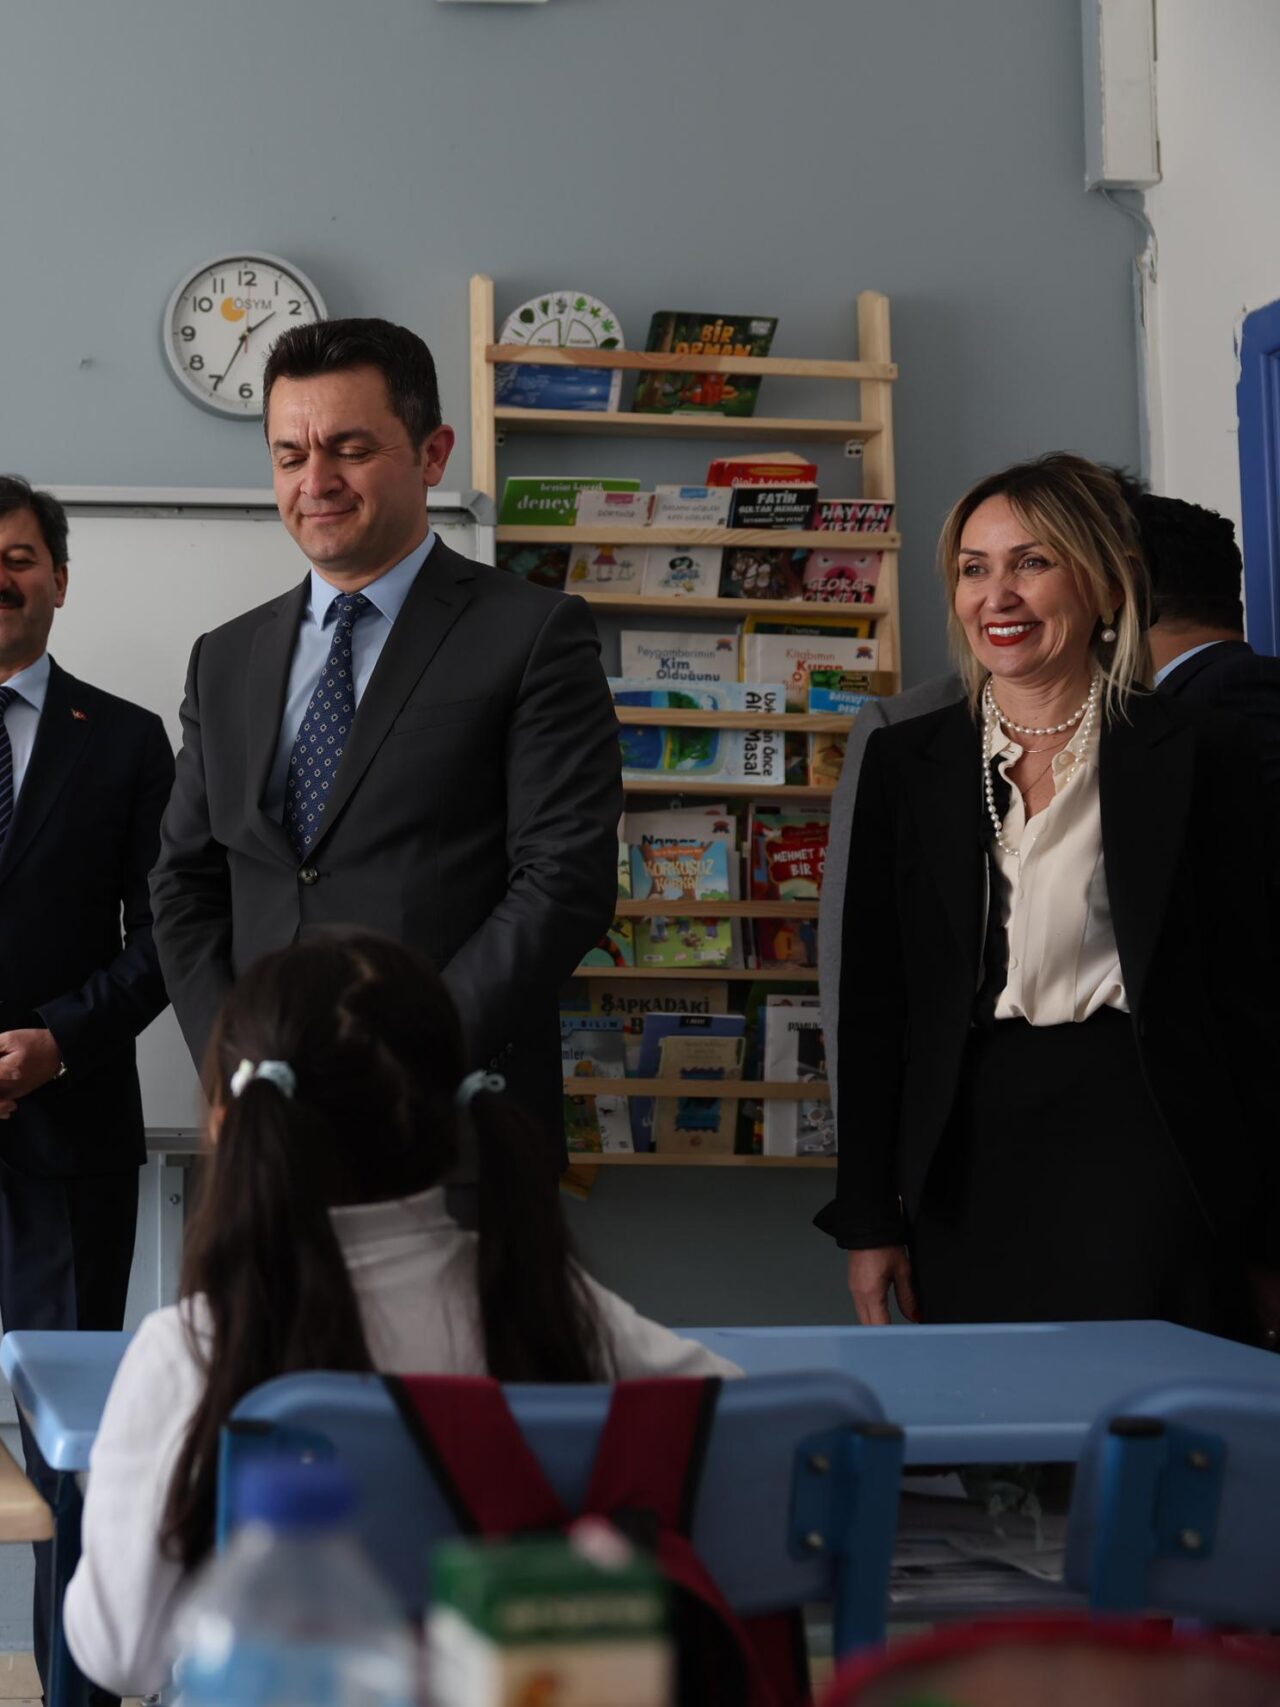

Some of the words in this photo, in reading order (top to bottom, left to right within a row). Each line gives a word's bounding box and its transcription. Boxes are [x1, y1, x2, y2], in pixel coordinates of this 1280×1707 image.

[213, 278, 224, 294] 11
[238, 270, 257, 286] 12
[274, 280, 279, 296] 1
[193, 296, 213, 312] 10
[288, 300, 302, 315] 2
[181, 326, 196, 342] 9
[700, 318, 735, 343] BİR
[189, 355, 204, 371] 8
[209, 374, 223, 391] 7
[239, 383, 253, 399] 6
[756, 490, 797, 504] FATİH
[822, 504, 890, 520] HAYVAN
[807, 576, 871, 592] GEORGE
[660, 657, 690, 669] Kim
[763, 746, 778, 776] Önce
[773, 848, 815, 863] MEHMET
[790, 861, 812, 876] BİR
[601, 992, 711, 1017] ŞAPKADAKİ
